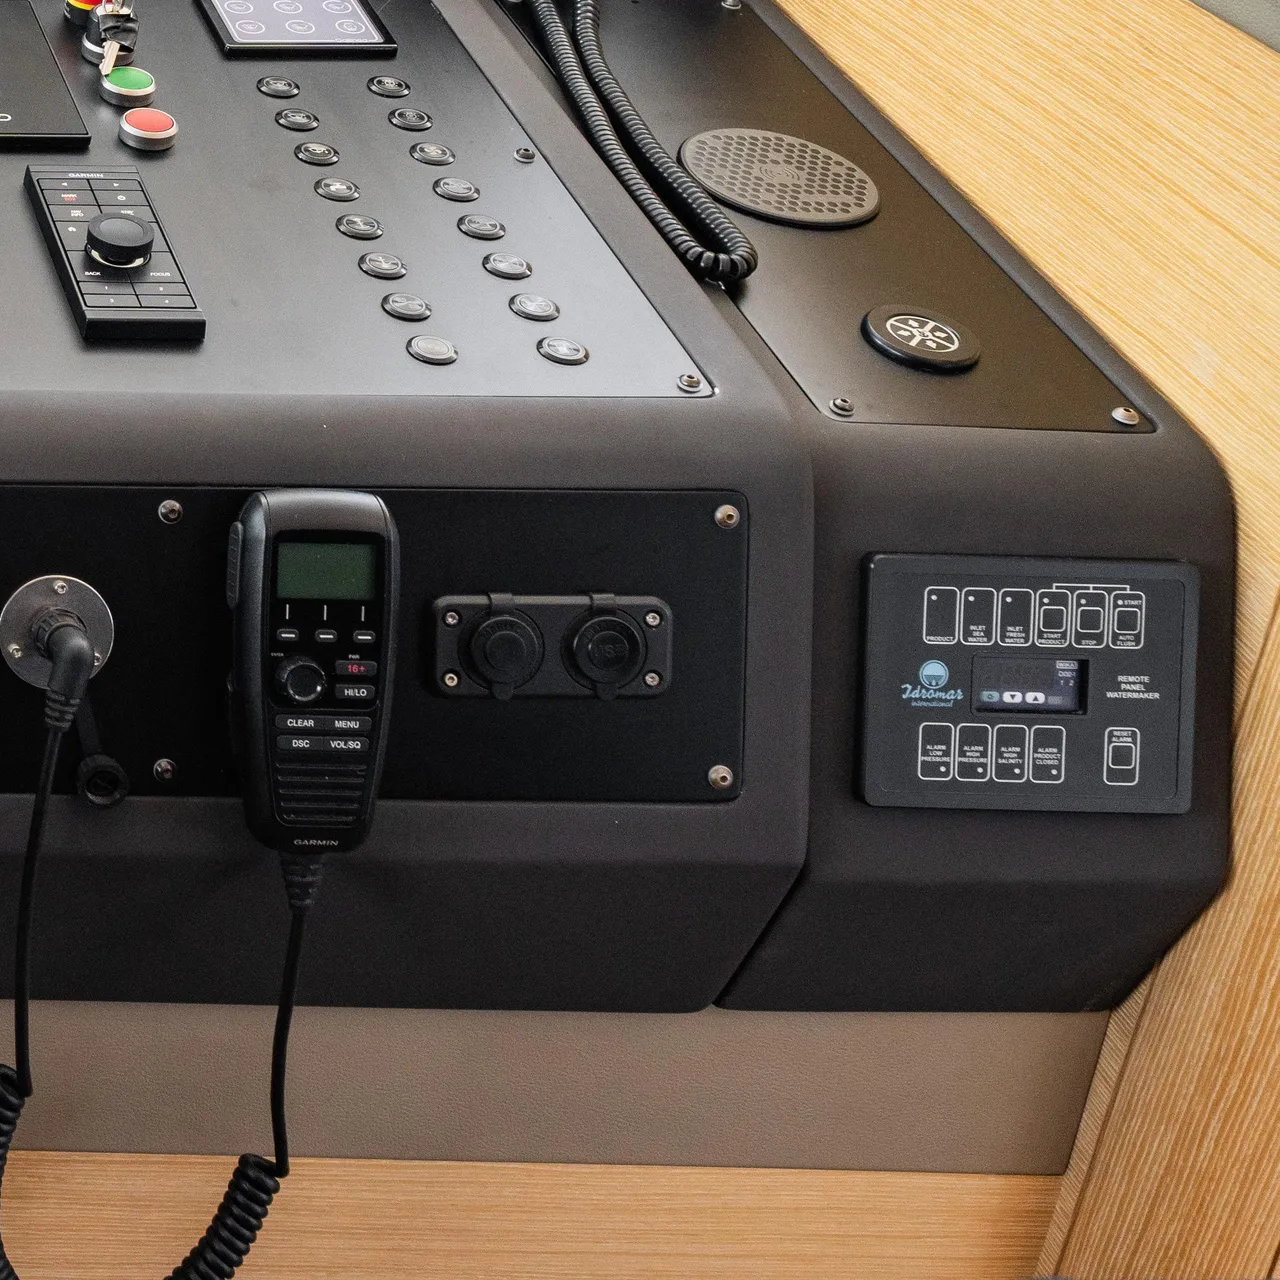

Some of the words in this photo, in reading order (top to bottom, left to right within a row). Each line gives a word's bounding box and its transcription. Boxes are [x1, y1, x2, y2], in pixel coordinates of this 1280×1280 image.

[347, 664, 365, 673] 16+
[1117, 675, 1150, 683] REMOTE
[1121, 683, 1145, 691] PANEL
[344, 688, 367, 697] HI/LO
[1106, 691, 1160, 699] WATERMAKER
[287, 719, 314, 728] CLEAR
[335, 720, 360, 729] MENU
[292, 739, 310, 748] DSC
[330, 740, 361, 750] VOL/SQ
